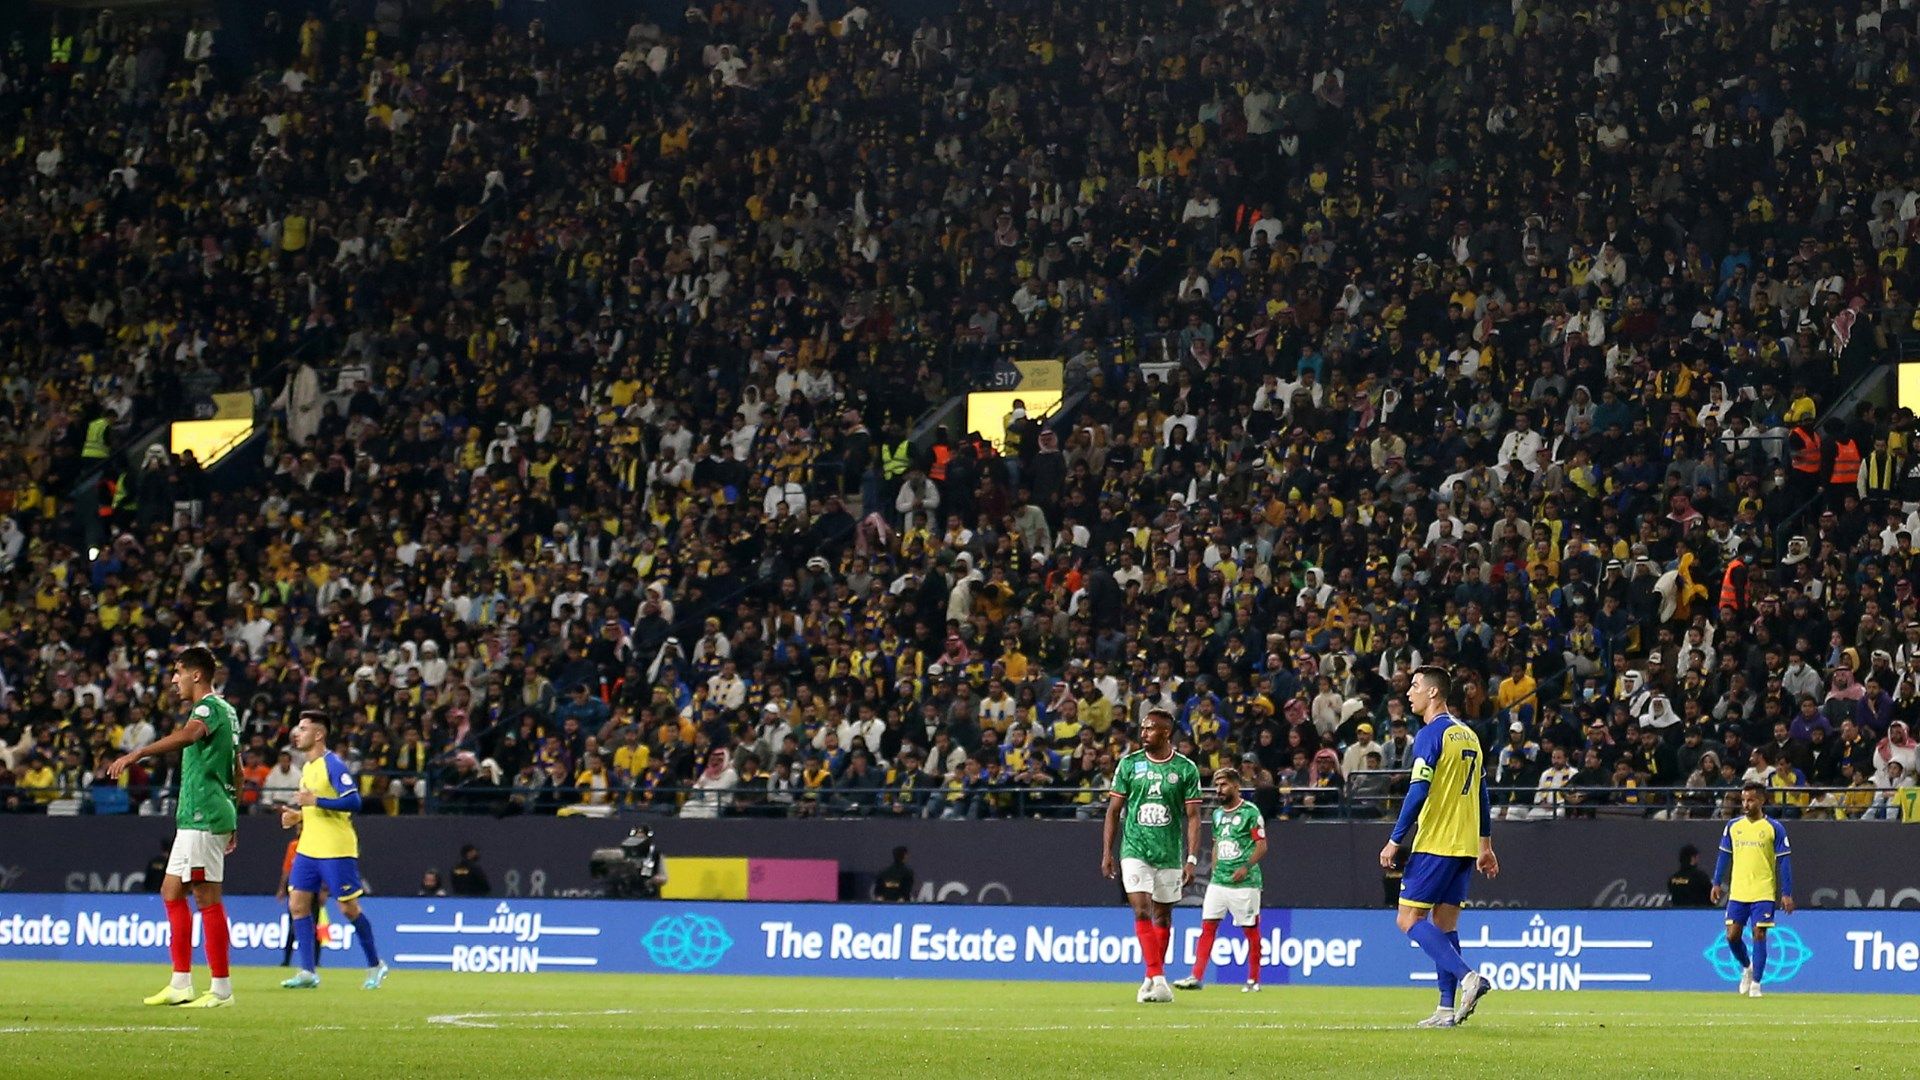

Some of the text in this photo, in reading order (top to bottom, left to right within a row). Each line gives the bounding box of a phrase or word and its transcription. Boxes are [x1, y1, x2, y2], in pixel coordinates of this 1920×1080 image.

[995, 371, 1016, 386] S17
[1461, 749, 1477, 795] 7
[1906, 793, 1917, 818] 7
[0, 912, 70, 946] state
[76, 911, 202, 948] Nationl
[760, 921, 824, 960] The
[830, 922, 903, 961] Real
[909, 923, 1017, 962] Estate
[1025, 925, 1174, 965] Nationl
[451, 945, 539, 973] ROSHN
[1846, 929, 1920, 972] The
[1480, 961, 1582, 991] ROSHN
